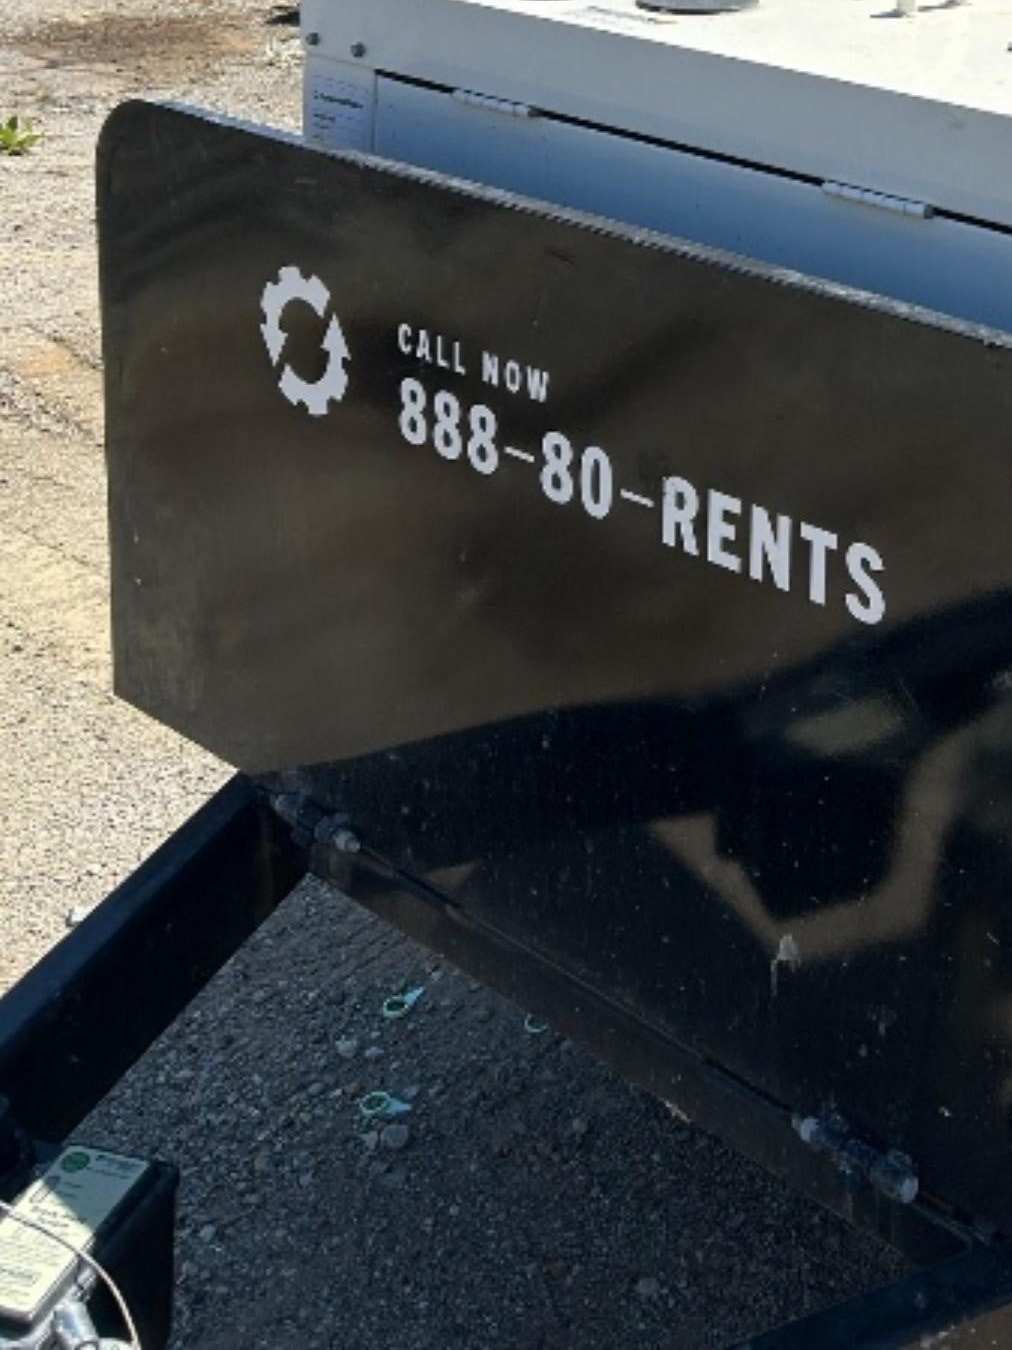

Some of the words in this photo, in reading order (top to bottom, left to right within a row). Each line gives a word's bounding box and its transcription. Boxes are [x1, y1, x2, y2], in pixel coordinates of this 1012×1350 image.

[398, 323, 466, 375] CALL
[482, 351, 550, 402] NOW
[399, 378, 887, 624] 888-80-RENTS
